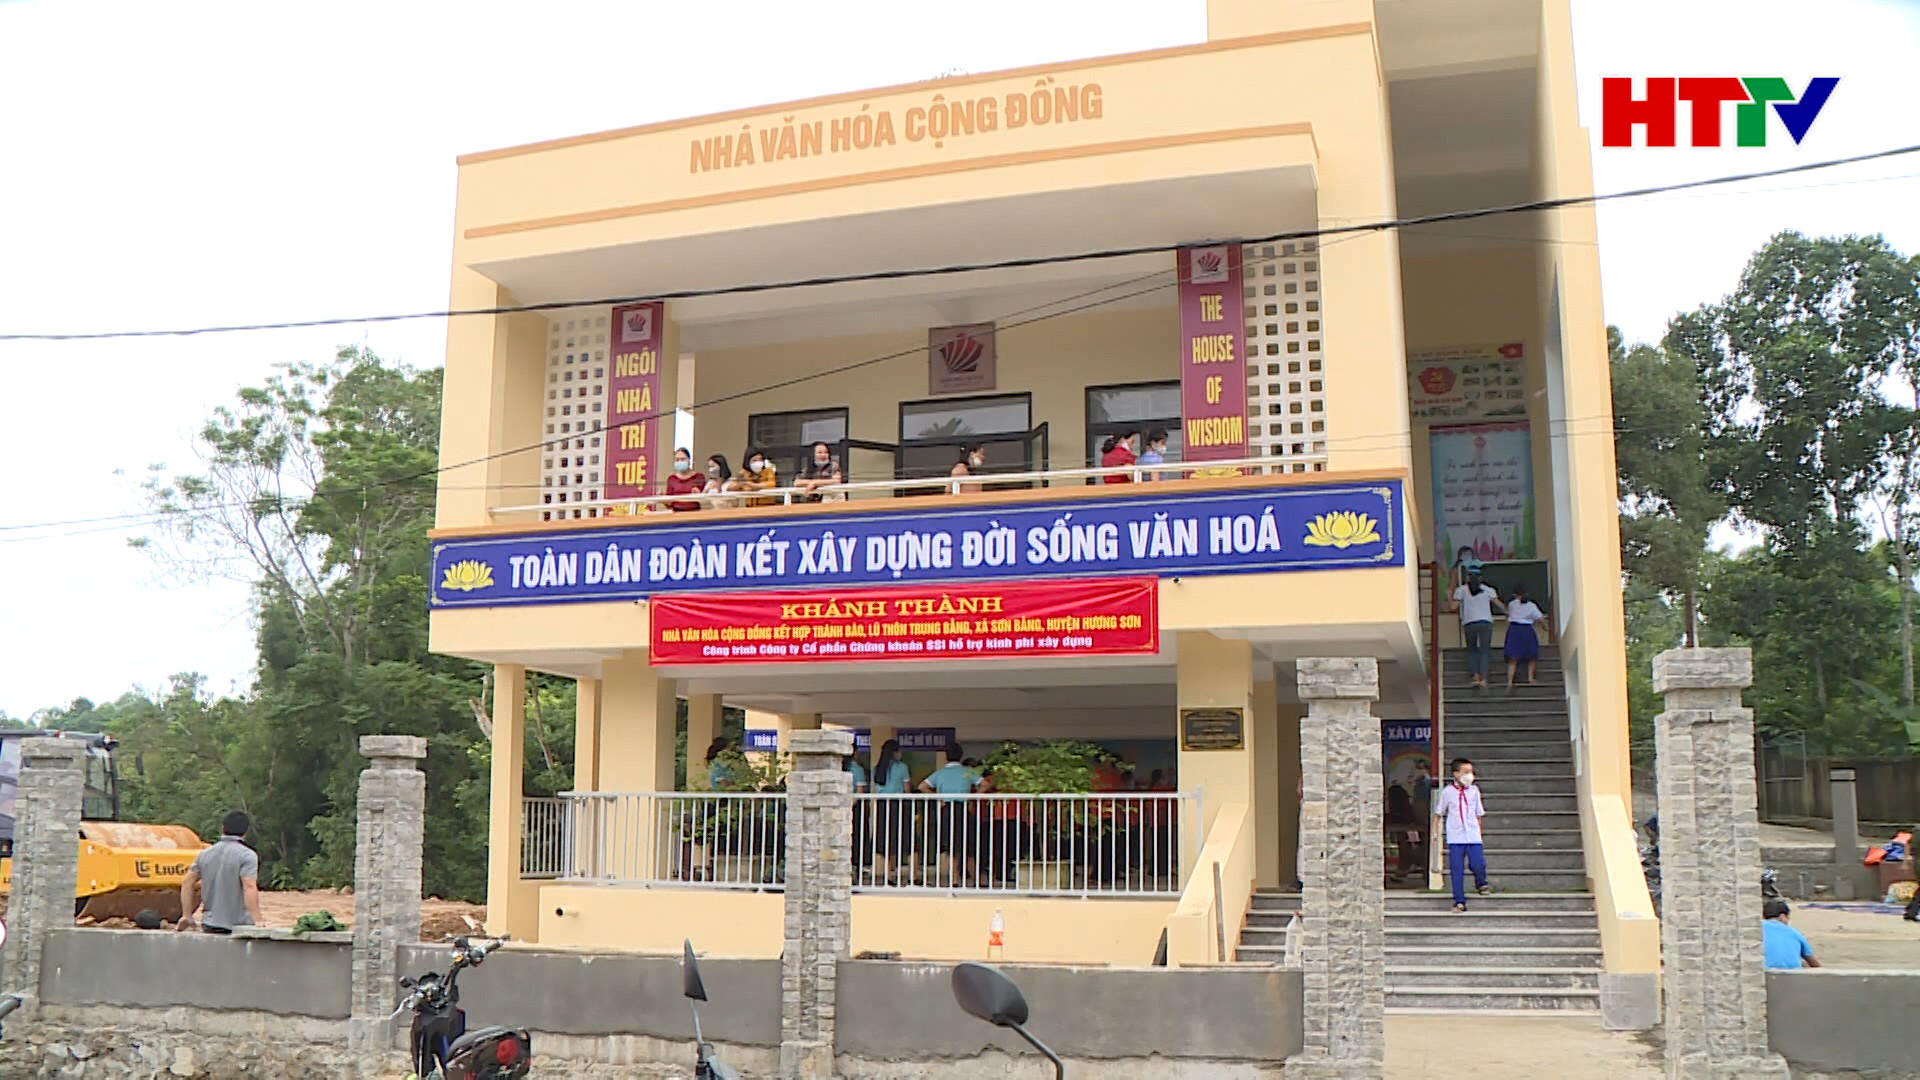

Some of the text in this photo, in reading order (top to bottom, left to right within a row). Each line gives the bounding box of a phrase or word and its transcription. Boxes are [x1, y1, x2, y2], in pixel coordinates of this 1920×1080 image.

[759, 115, 823, 162] VĂN
[830, 103, 897, 153] HÓA
[905, 93, 998, 149] CỘNG
[1005, 75, 1104, 129] ĐỒNG
[1200, 295, 1223, 322] THE
[615, 346, 656, 378] NGÔI
[1192, 334, 1234, 364] HOUSE
[616, 382, 652, 414] NHÀ
[1206, 376, 1222, 404] OF
[619, 420, 645, 450] TRÍ
[1187, 416, 1243, 447] WISDOM
[615, 455, 647, 492] TUỆ
[509, 505, 1281, 588] TOÀN DÂN ĐOÀN KẾT XÂY DỰNG ĐỜI SỐNG VĂN HOÁ
[780, 593, 1004, 620] KHÁNH THÀNH
[721, 625, 745, 643] CỘNG
[773, 623, 791, 640] KẾT
[909, 620, 942, 636] TRUNG
[1046, 614, 1080, 633] HUYỆN
[1119, 614, 1142, 629] SƠN
[702, 644, 730, 657] Công
[731, 644, 757, 656] trình
[759, 643, 787, 656] Công
[789, 643, 800, 655] ty
[985, 637, 1012, 650] kinh
